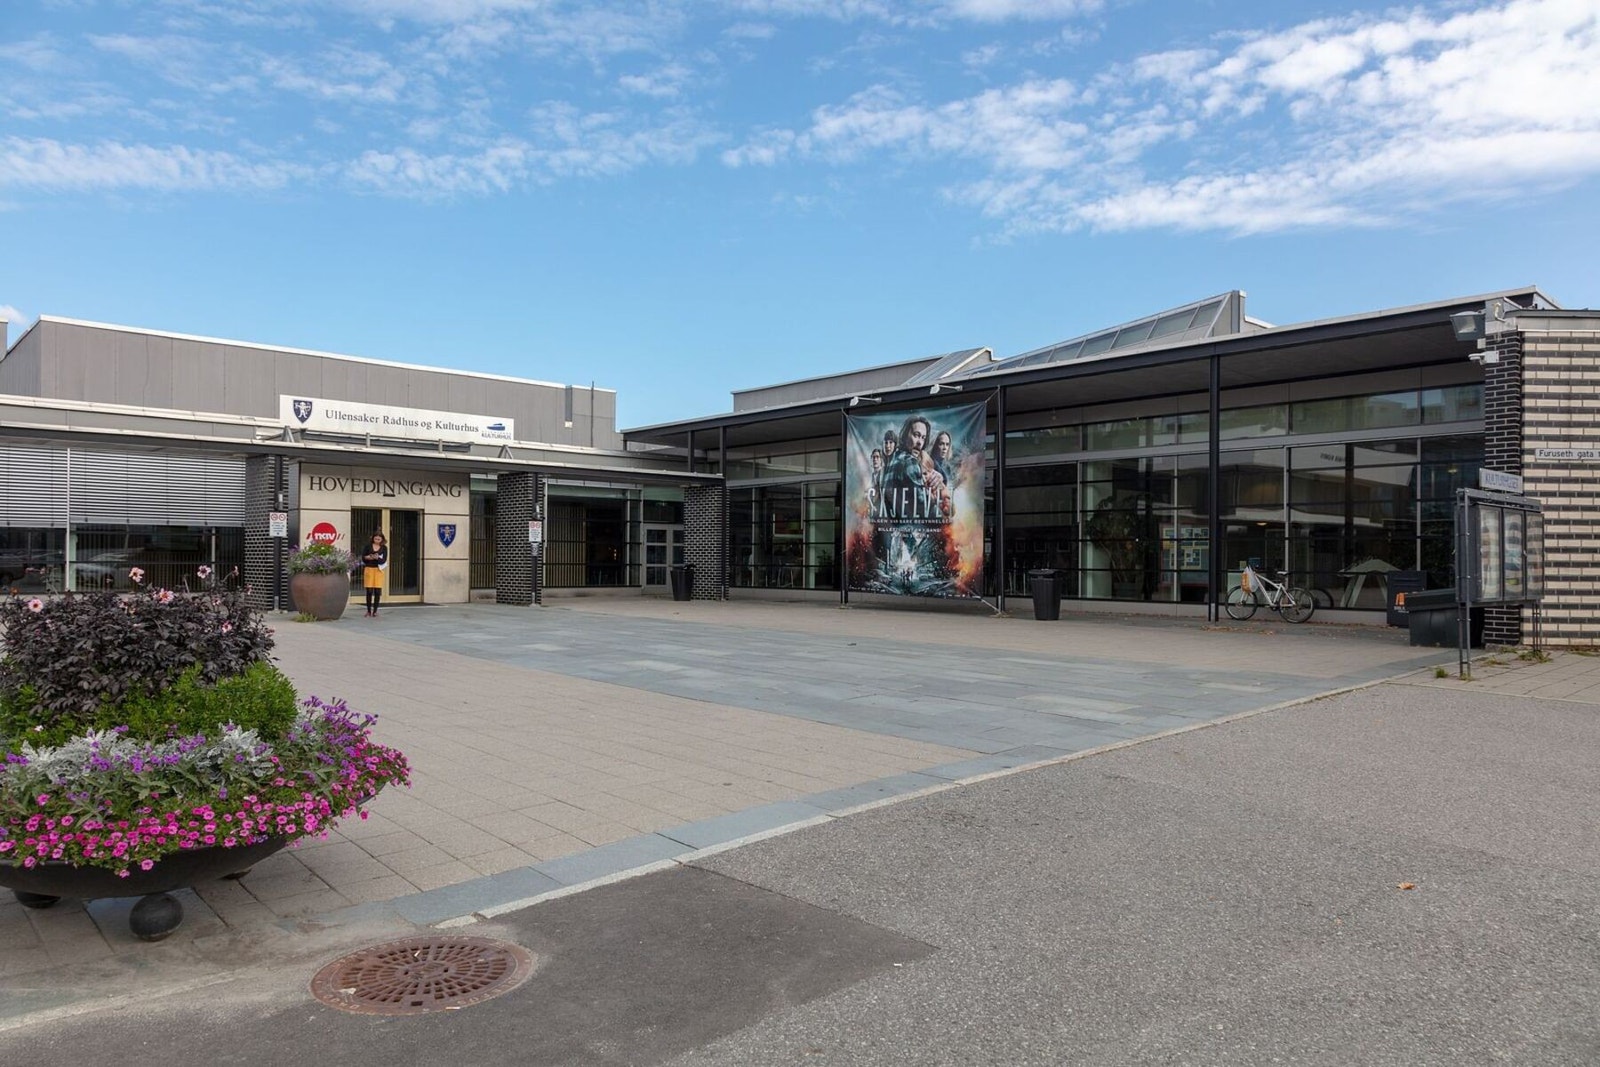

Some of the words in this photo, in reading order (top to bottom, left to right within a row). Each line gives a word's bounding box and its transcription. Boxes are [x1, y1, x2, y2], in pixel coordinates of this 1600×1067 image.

[325, 410, 380, 423] Ullensaker
[382, 415, 419, 427] Rådhus
[420, 421, 432, 430] og
[435, 420, 479, 433] Kulturhus
[1538, 449, 1573, 458] Furuseth
[1577, 450, 1594, 459] gata
[309, 475, 462, 498] HOVEDINNGANG
